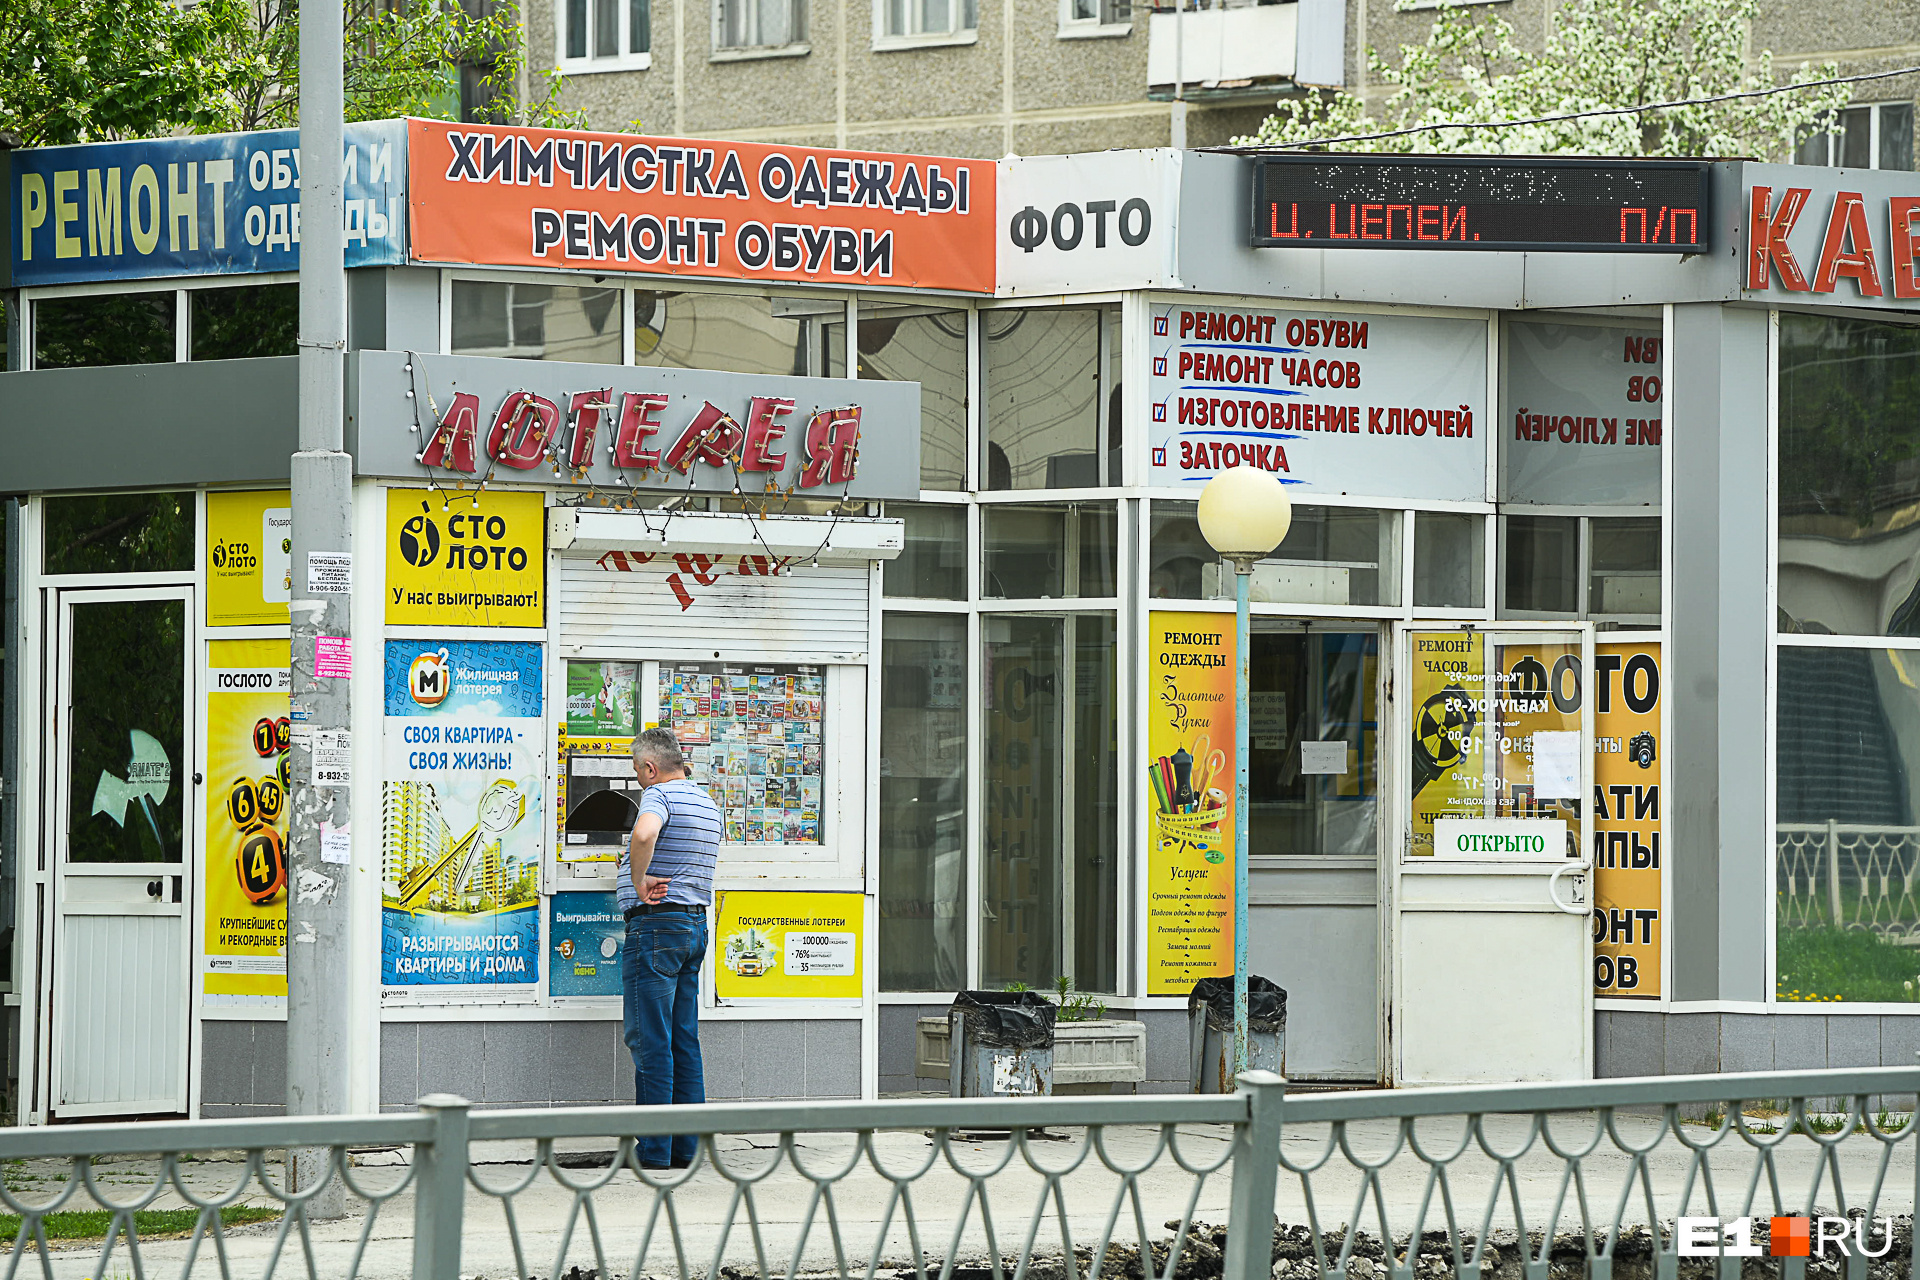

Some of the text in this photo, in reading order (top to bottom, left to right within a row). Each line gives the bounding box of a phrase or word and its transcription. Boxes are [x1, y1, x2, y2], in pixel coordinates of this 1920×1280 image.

[370, 142, 392, 184] И
[447, 133, 970, 214] ХИМЧИСТКА ОДЕЖДЫ
[21, 159, 234, 261] РЕМОНТ
[244, 197, 397, 253] ОДЕДЫ
[1010, 198, 1151, 253] ФОТО
[532, 209, 893, 276] РЕМОНТ ОБУВИ
[1179, 311, 1368, 349] РЕМОНТ ОБУВИ
[1179, 352, 1360, 389] РЕМОНТ ЧАСОВ
[1178, 397, 1473, 438] ИЗГОТОВЛЕНИЕ КЛЮЧЕЙ
[420, 387, 863, 489] ЛОТЕРЕЯ
[1179, 441, 1290, 473] ЗАТОЧКА
[448, 515, 506, 540] СТО
[228, 543, 249, 554] СТО
[228, 556, 256, 567] ЛОТО
[446, 545, 527, 571] ЛОТО
[393, 588, 538, 609] У нас выигрывают!
[1164, 632, 1222, 645] РЕМОНТ
[1418, 640, 1474, 653] РЕМОНТ
[1160, 653, 1226, 669] ОДЕЖДЫ
[1423, 660, 1468, 673] ЧАСОВ
[218, 673, 272, 688] ГОСЛОТО
[278, 671, 291, 679] ПОКА
[455, 667, 519, 681] Жилищная
[455, 684, 502, 699] лотерея
[1160, 675, 1225, 702] Золотые
[1508, 653, 1660, 715] ФОТО
[1165, 702, 1211, 733] Ручки
[404, 725, 440, 743] СВОЯ
[445, 726, 513, 743] КВАРТИРА
[409, 751, 512, 770] СВОЯ ЖИЗНЬ!
[1457, 834, 1545, 852] ОТКРЫТО
[251, 843, 270, 884] 4
[1171, 867, 1209, 882] Услуги:
[1152, 892, 1226, 901] Срочный ремонт одежды
[556, 913, 610, 924] Выигрывайте
[738, 917, 845, 926] ГОСУДАРСТВЕННЫЕ ЛОТЕРЕИ
[1151, 909, 1172, 917] Подгон
[1174, 909, 1196, 917] одежды
[1206, 909, 1227, 918] фигуре
[220, 917, 287, 930] КРУПНЕЙШИЕ СУ
[1157, 926, 1196, 934] Реставрация
[220, 935, 226, 944] И
[227, 935, 279, 947] РЕКОРДНЫЕ
[402, 935, 519, 953] РАЗЫГРЫВАЮТСЯ
[795, 950, 810, 958] 76%
[1160, 959, 1184, 967] Ремонт
[395, 957, 526, 976] КВАРТИРЫ И ДОМА
[801, 963, 809, 971] 35
